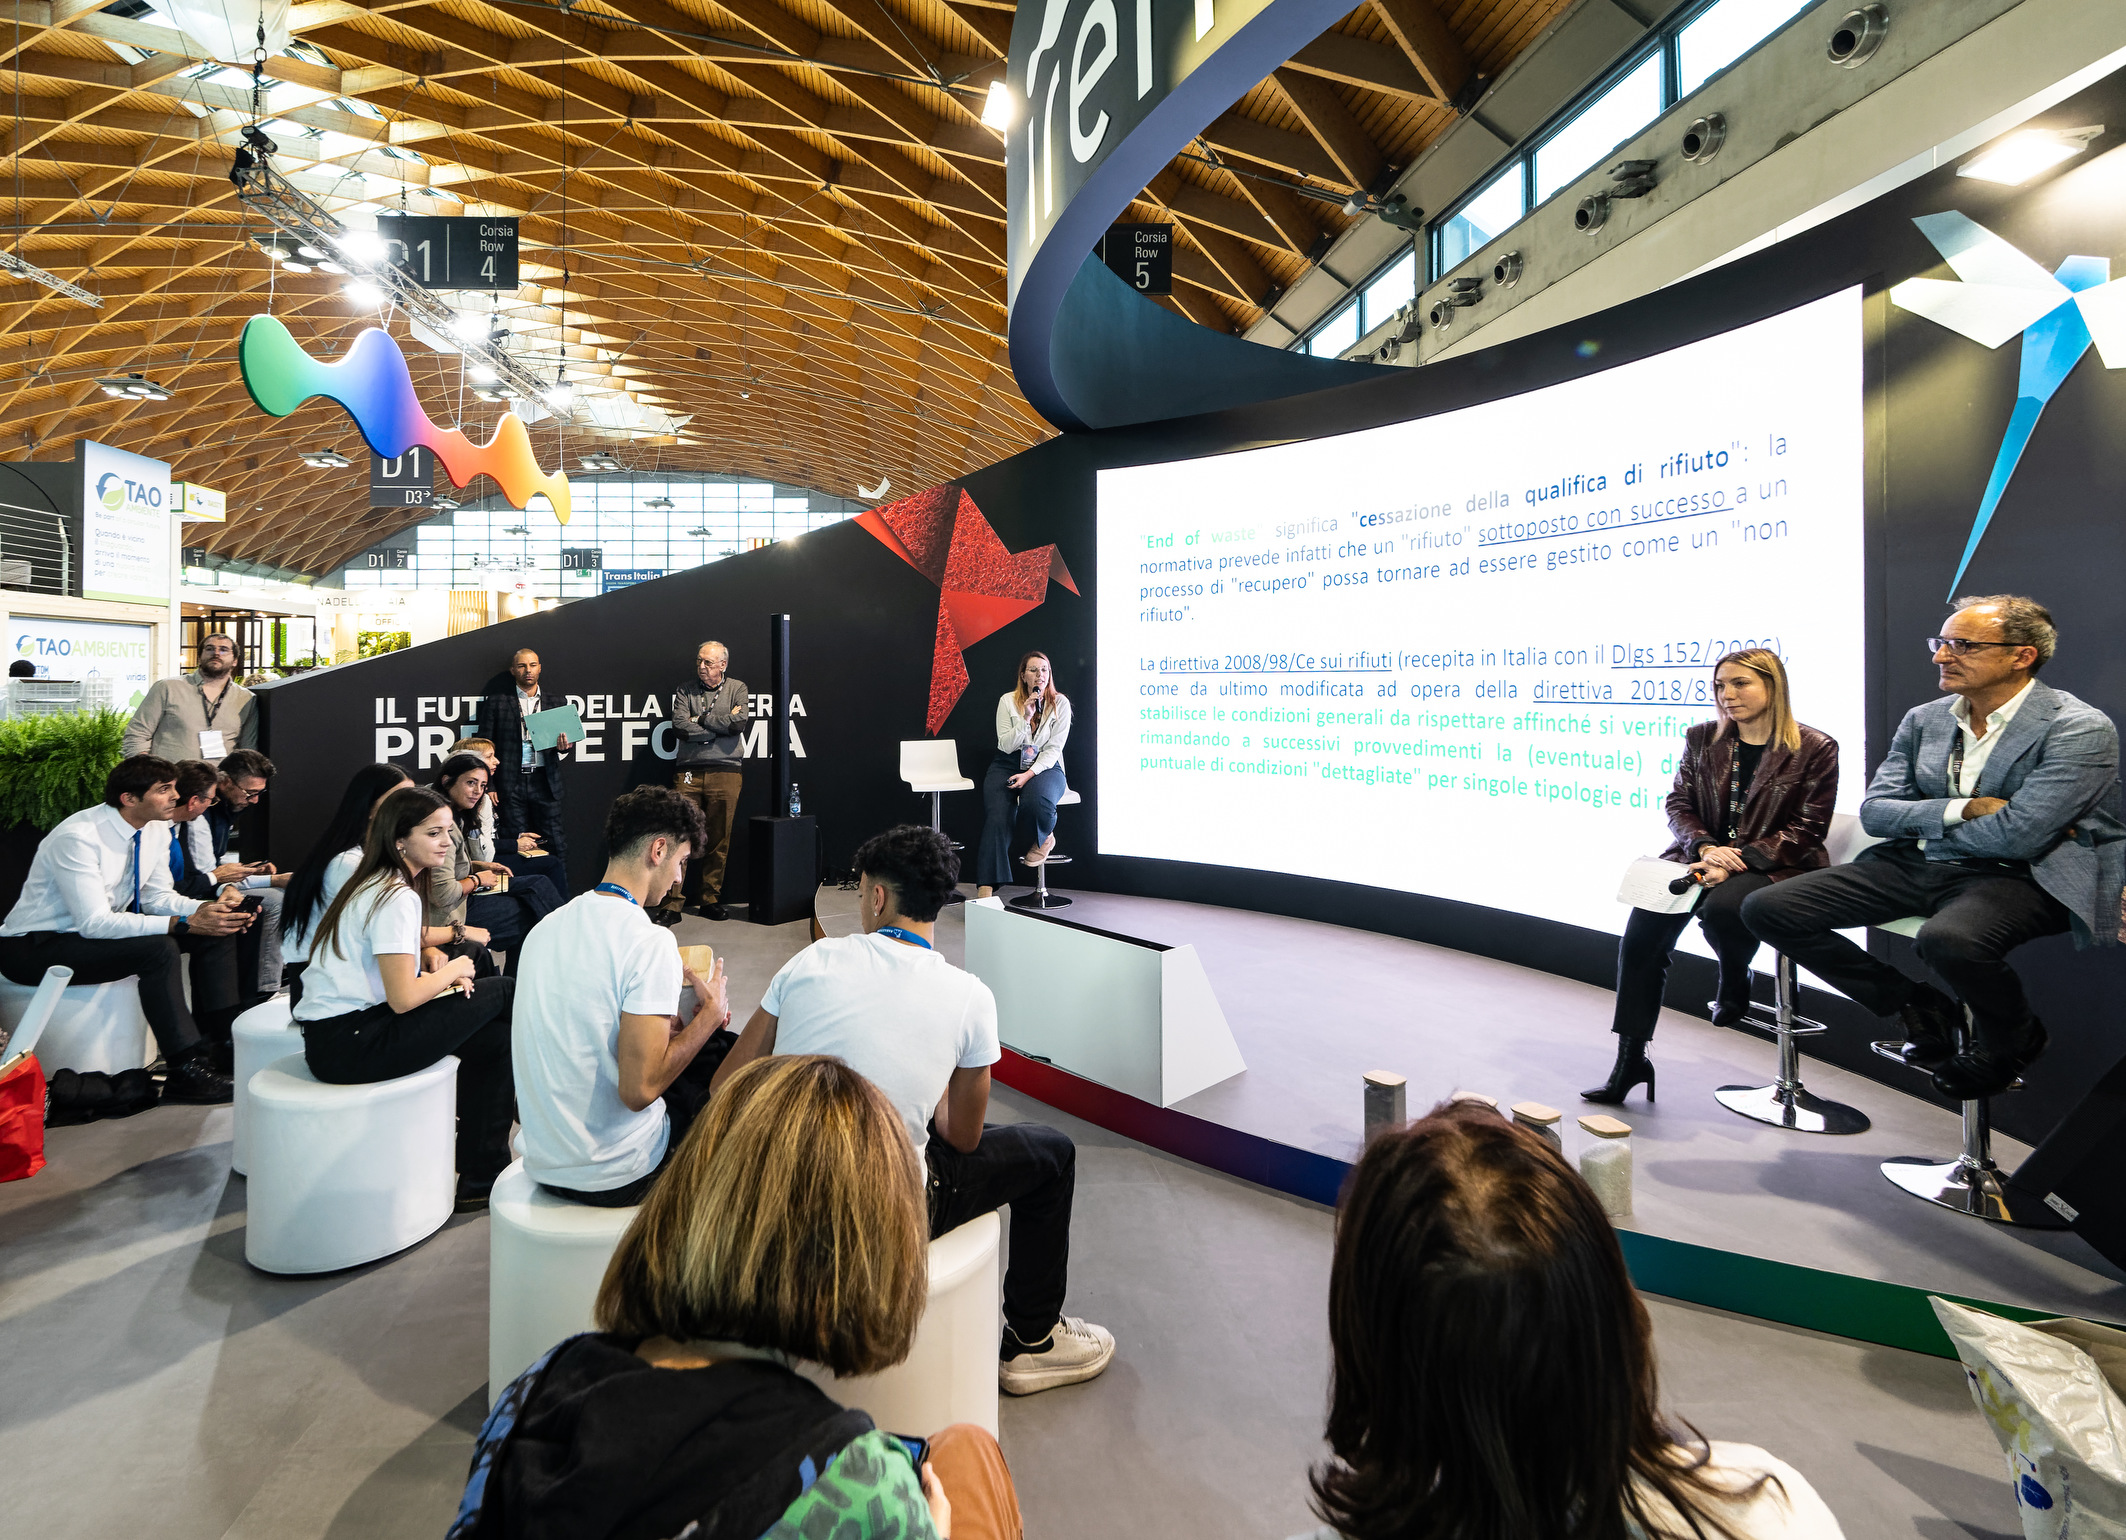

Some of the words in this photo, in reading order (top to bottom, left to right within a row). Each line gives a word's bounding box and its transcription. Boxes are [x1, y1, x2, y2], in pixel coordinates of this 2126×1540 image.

[480, 224, 513, 237] Corsia
[1135, 231, 1167, 243] Corsia
[480, 240, 504, 252] Row
[1135, 247, 1159, 259] Row
[480, 256, 497, 283] 4
[1135, 262, 1150, 289] 5
[382, 447, 420, 478] D1
[124, 479, 162, 508] TAO
[405, 490, 422, 504] D3
[1184, 530, 1201, 545] of
[1276, 517, 1338, 539] significa
[1352, 503, 1452, 527] "cessazione
[1465, 490, 1510, 512] della
[1524, 474, 1607, 507] qualifica
[1623, 463, 1643, 486] di
[1660, 440, 1748, 479] rifiuto":
[1769, 434, 1787, 456] la
[126, 504, 161, 518] AMBIENTE
[1139, 556, 1213, 574] normativa
[1218, 550, 1280, 571] prevede
[1286, 544, 1332, 563] infatti
[1337, 540, 1367, 558] che
[1373, 541, 1394, 554] un
[1401, 525, 1471, 551] "rifiuto"
[1478, 510, 1580, 543] sottoposto
[1586, 508, 1623, 528] con
[1630, 491, 1727, 522] successo
[1735, 487, 1748, 504] a
[1759, 479, 1788, 500] un
[95, 528, 121, 539] Quando
[128, 535, 145, 544] vicino
[95, 549, 115, 558] arriva
[121, 553, 150, 563] momento
[368, 554, 384, 567] D1
[397, 558, 403, 567] 2
[563, 554, 578, 568] D1
[591, 559, 597, 567] 3
[1139, 584, 1204, 601] processo
[1209, 579, 1224, 595] di
[1231, 571, 1315, 594] "recupero"
[1322, 572, 1369, 590] possa
[1376, 565, 1441, 583] tornare
[1449, 557, 1470, 576] ad
[1478, 548, 1538, 573] essere
[1546, 543, 1612, 571] gestito
[1622, 536, 1681, 558] come
[1691, 530, 1718, 549] un
[1731, 520, 1788, 542] "non
[604, 572, 632, 581] Trans
[1138, 606, 1195, 622] rifiuto".
[1140, 657, 1155, 671] La
[1159, 656, 1220, 671] direttiva
[1224, 653, 1314, 671] 2008/98/Ce
[1319, 653, 1343, 669] sui
[1348, 651, 1392, 669] rifiuti
[1398, 650, 1475, 671] (recepita
[1481, 649, 1496, 666] in
[1503, 647, 1548, 666] Italia
[1553, 650, 1588, 665] con
[1595, 644, 1604, 664] il
[1612, 643, 1655, 666] Dlgs
[1139, 683, 1179, 696] come
[1189, 681, 1208, 696] da
[1219, 681, 1268, 696] ultimo
[1280, 680, 1364, 697] modificata
[1376, 681, 1397, 697] ad
[1410, 683, 1461, 700] opera
[1474, 680, 1518, 698] della
[1533, 680, 1613, 700] direttiva
[375, 697, 407, 724] IL
[417, 696, 488, 723] FUT
[565, 694, 663, 719] DELLA
[1139, 706, 1207, 720] stabilisce
[1212, 706, 1226, 721] le
[1231, 707, 1311, 723] condizioni
[1315, 708, 1384, 727] generali
[1389, 709, 1411, 726] da
[1416, 709, 1507, 732] rispettare
[1512, 713, 1592, 734] affinché
[1599, 716, 1614, 735] si
[375, 722, 605, 769] PRE
[621, 720, 807, 761] FOMA
[1140, 730, 1231, 747] rimandando
[1242, 736, 1251, 748] a
[1262, 735, 1341, 752] successivi
[1352, 739, 1482, 760] provvedimenti
[1496, 743, 1513, 762] la
[1528, 744, 1643, 776] (eventuale)
[1140, 756, 1206, 772] puntuale
[1210, 757, 1224, 771] di
[1228, 759, 1308, 776] condizioni
[1312, 762, 1421, 785] "dettagliate"
[1427, 774, 1459, 790] per
[1462, 773, 1529, 796] singole
[1533, 779, 1623, 808] tipologie
[1629, 787, 1649, 808] di
